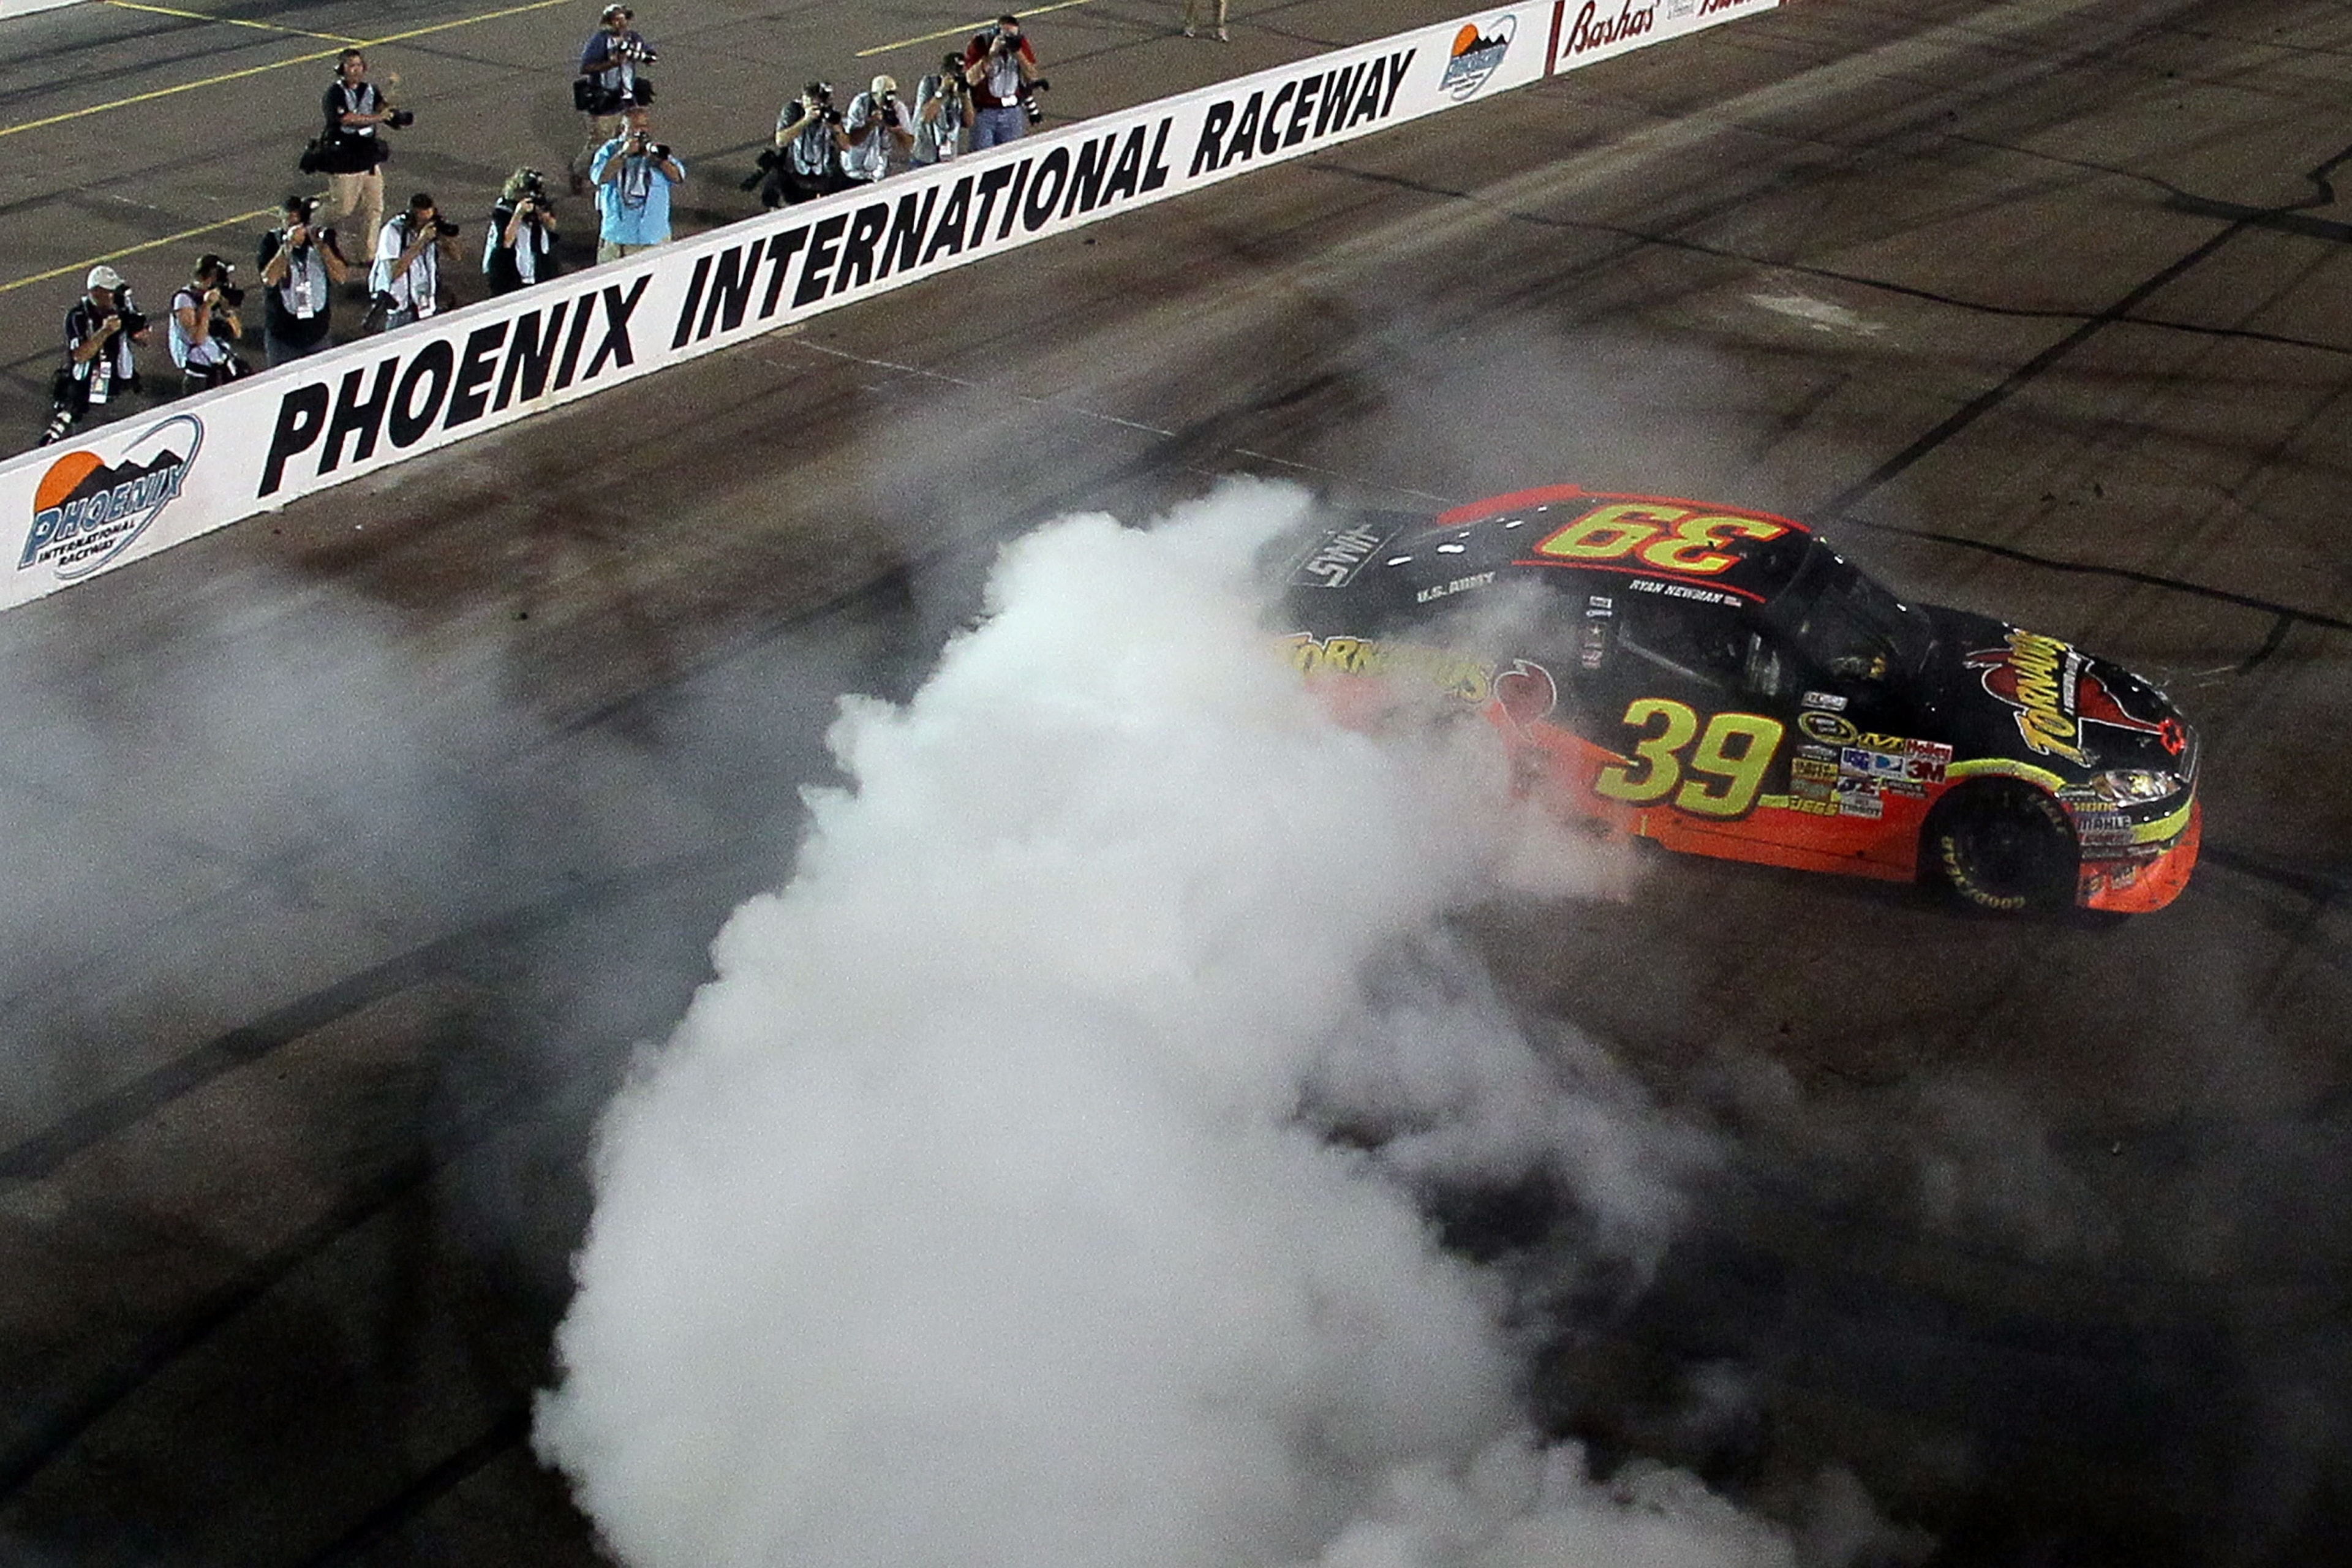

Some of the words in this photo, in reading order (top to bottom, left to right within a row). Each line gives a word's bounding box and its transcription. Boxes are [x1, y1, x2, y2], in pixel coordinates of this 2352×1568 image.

[258, 274, 653, 498] PHOENIX
[671, 117, 1174, 350] INTERNATIONAL
[1188, 48, 1415, 177] RACEWAY
[17, 464, 183, 570] PHOENIX
[38, 521, 135, 562] INTERNATIONAL
[58, 538, 116, 567] RACEWAY
[1537, 503, 1786, 574] 39
[1417, 586, 1448, 603] U.S.
[1449, 571, 1496, 594] ARMY
[1629, 579, 1665, 594] RYAN
[1664, 585, 1723, 603] NEWMAN
[1594, 698, 1785, 819] 39
[1907, 760, 1947, 783] 3M
